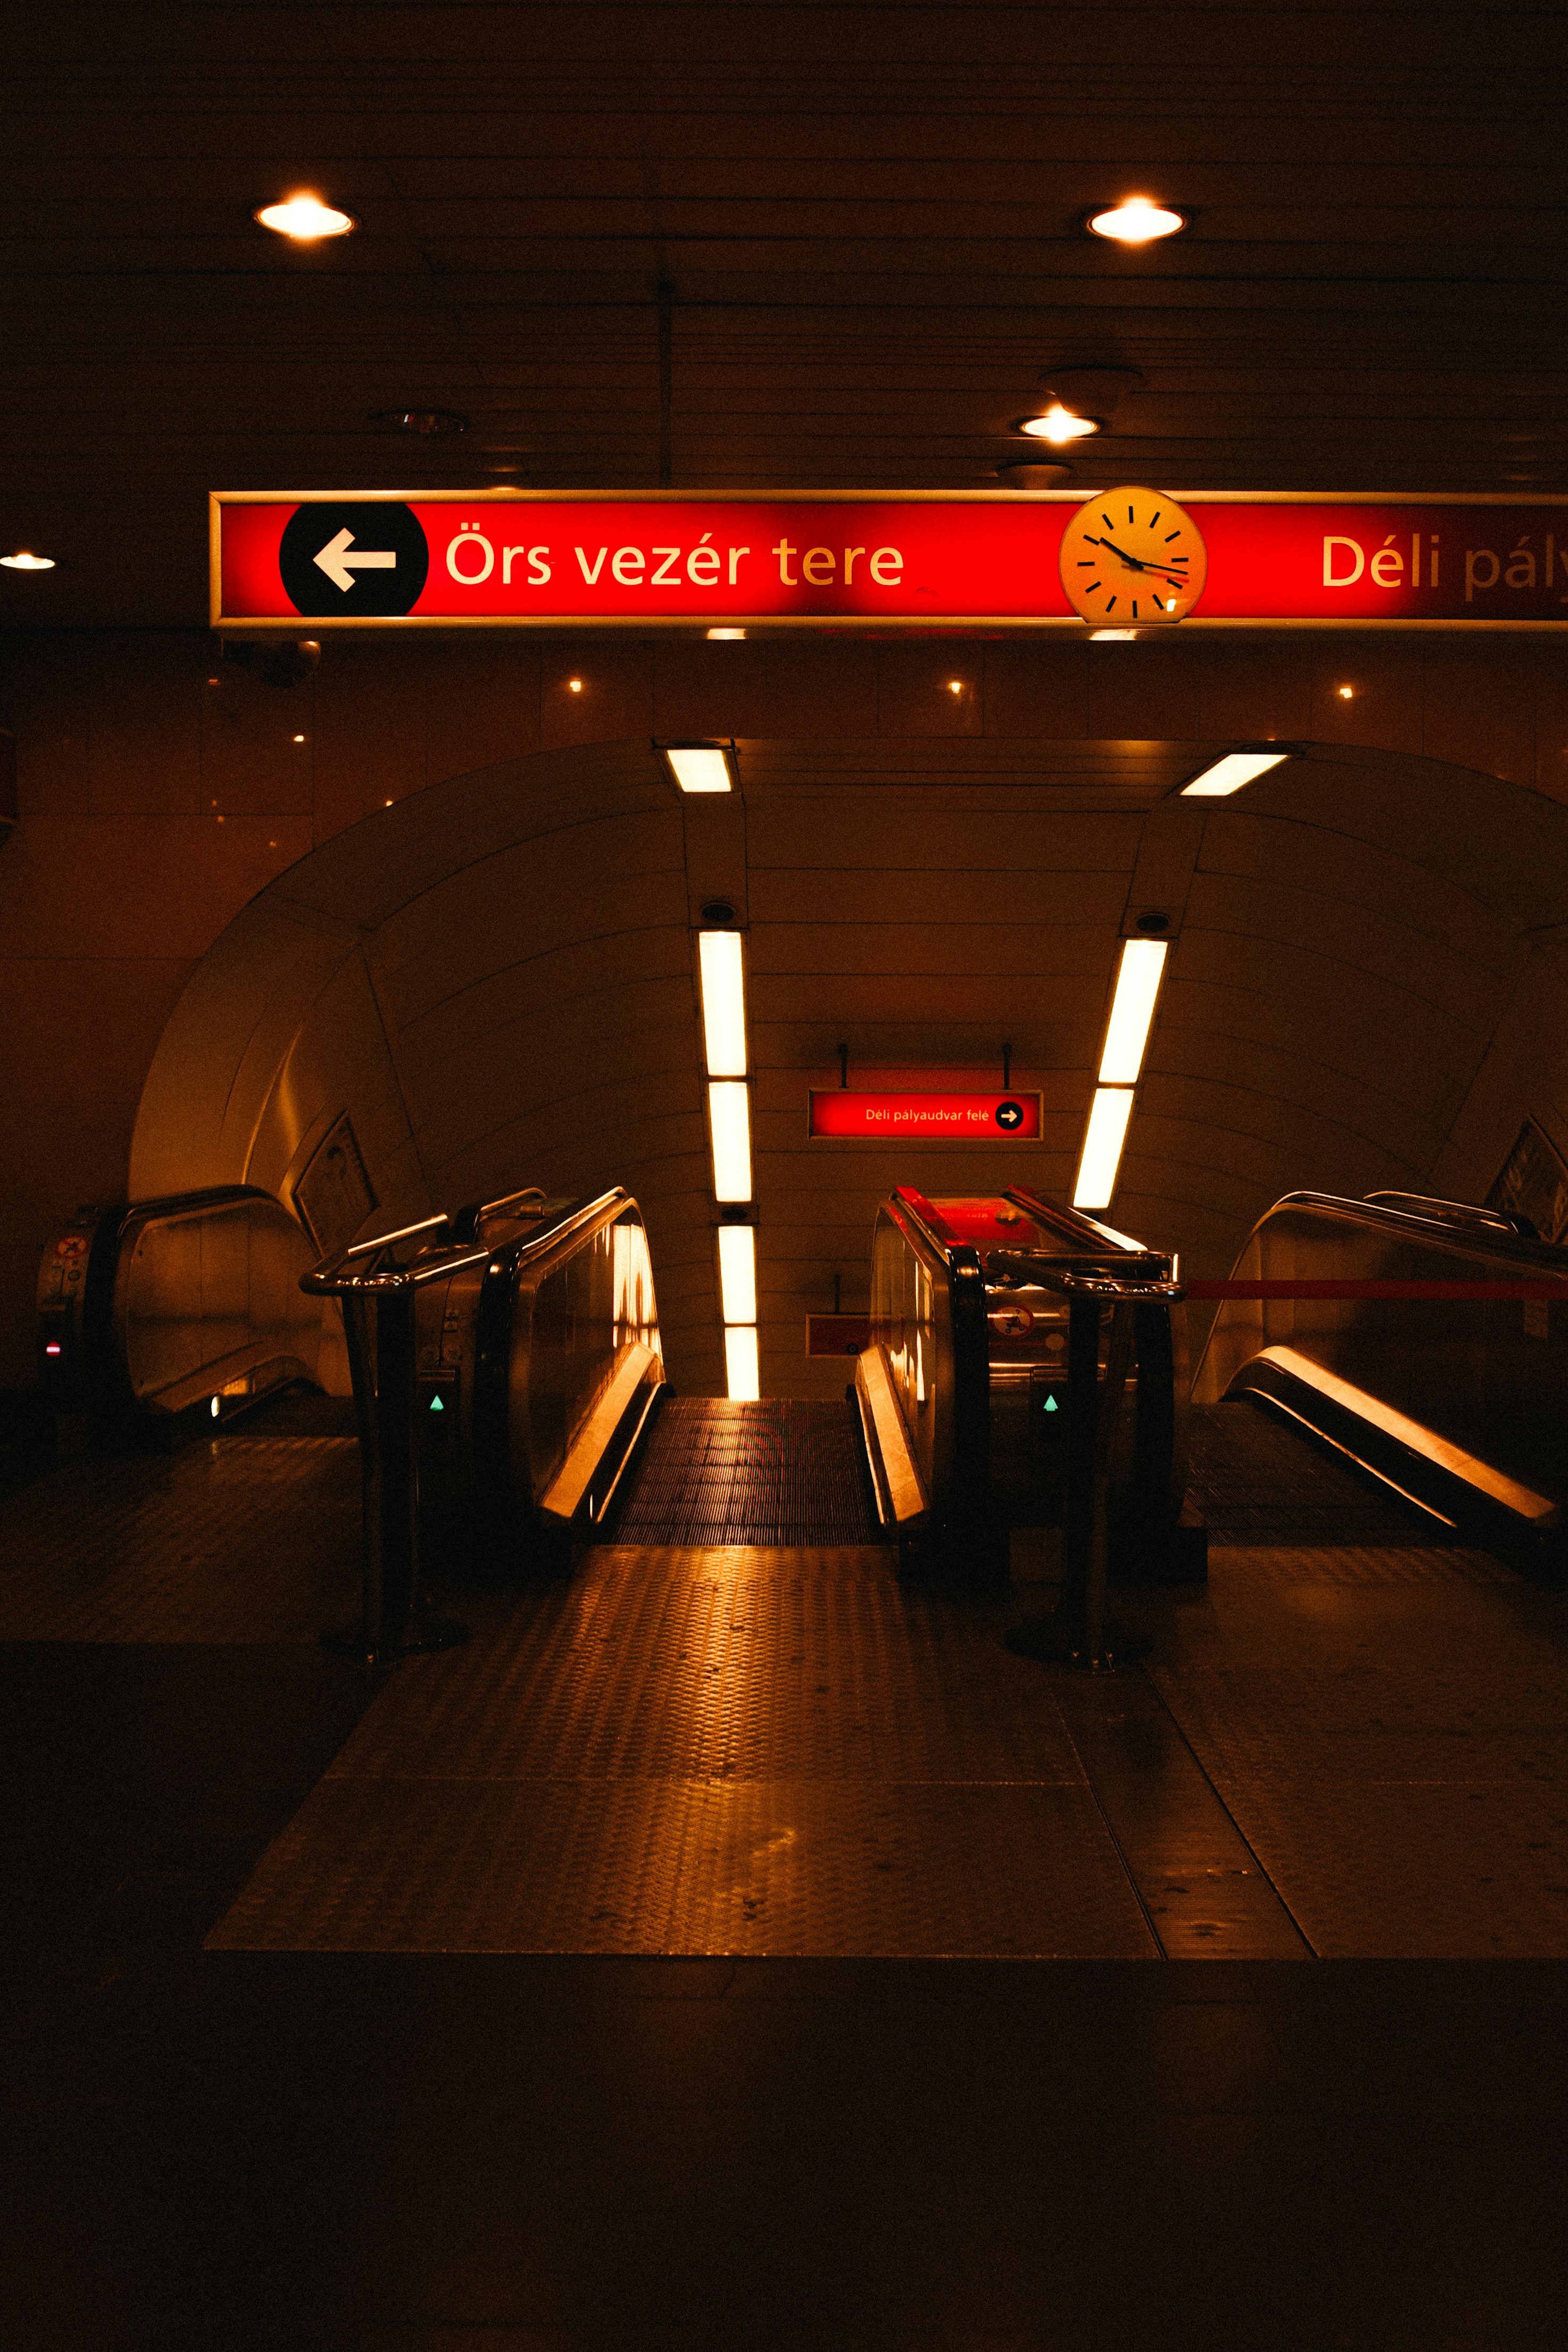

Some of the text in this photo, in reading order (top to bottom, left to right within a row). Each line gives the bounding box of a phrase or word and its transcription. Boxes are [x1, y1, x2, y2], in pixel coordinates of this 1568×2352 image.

[446, 523, 904, 586] Örs vezér tere
[1323, 533, 1568, 603] Déli pál
[866, 1108, 989, 1122] Déli pályaudvar felé
